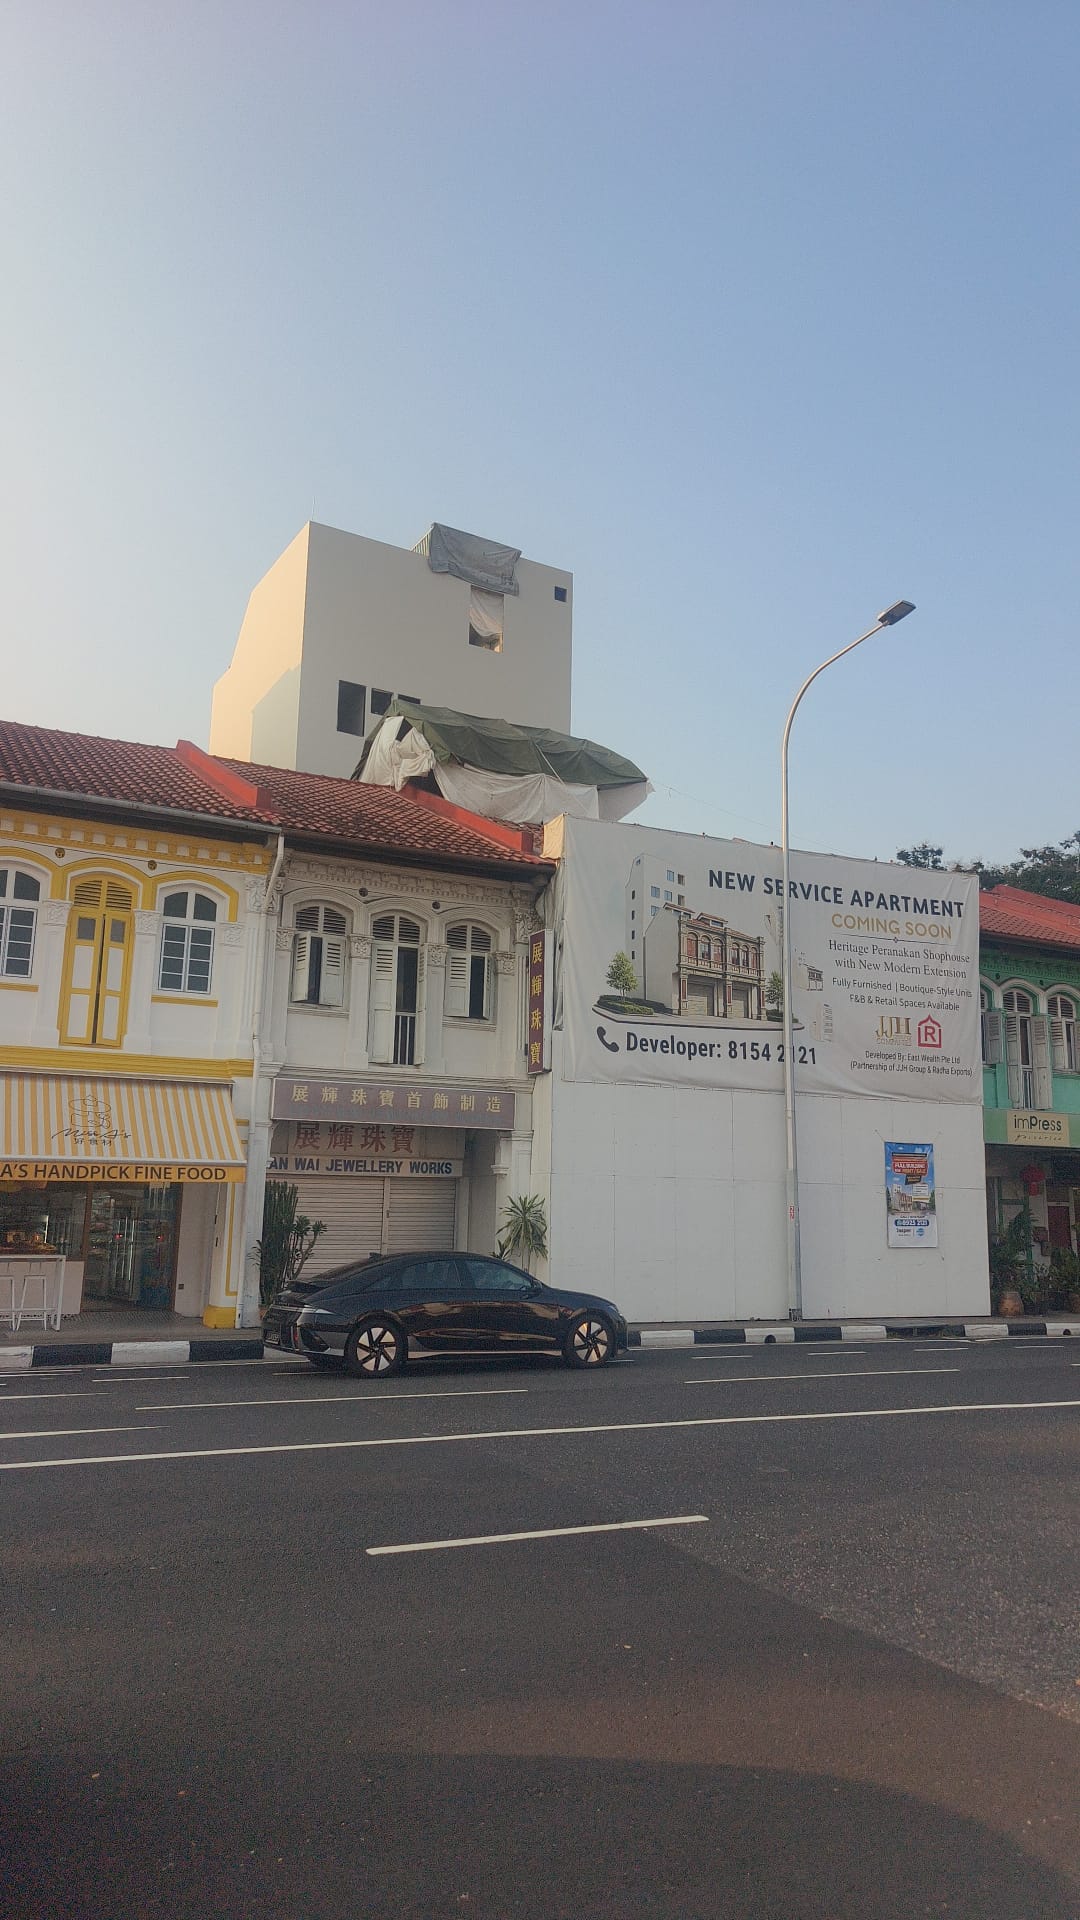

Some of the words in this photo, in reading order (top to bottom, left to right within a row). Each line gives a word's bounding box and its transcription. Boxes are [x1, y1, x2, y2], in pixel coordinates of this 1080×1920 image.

[708, 869, 755, 893] NEW
[763, 877, 844, 905] SERVICE
[850, 889, 964, 918] APARTMENT
[831, 913, 901, 935] COMING
[905, 921, 952, 939] SOON
[828, 939, 869, 954] Heritage
[871, 944, 921, 959] Peranakan
[923, 949, 970, 964] Shophouse
[835, 958, 856, 969] with
[858, 959, 881, 971] New
[884, 961, 921, 975] Modern
[923, 965, 967, 979] Extension
[832, 977, 851, 989] Fully
[852, 979, 892, 991] Furnished
[899, 983, 955, 998] Boutique-Style
[849, 994, 865, 1004] F&B
[867, 996, 873, 1004] &
[875, 996, 898, 1006] Retail
[899, 999, 926, 1009] Spaces
[927, 1001, 960, 1011] Available
[875, 1015, 912, 1039] JJH
[924, 1025, 937, 1042] R
[626, 1031, 721, 1060] Developer:
[728, 1040, 772, 1061] 8154
[865, 1050, 897, 1061] Developed
[907, 1053, 920, 1062] East
[850, 1061, 888, 1072] (Partnership
[888, 1063, 895, 1071] of
[908, 1065, 927, 1074] Group
[0, 1163, 28, 1178] A'S
[34, 1164, 131, 1179] HANDPICK
[134, 1166, 173, 1180] FINE
[177, 1167, 226, 1180] FOOD
[294, 1157, 320, 1171] WAI
[325, 1158, 403, 1174] JEWELLERY
[409, 1161, 453, 1175] WORKS
